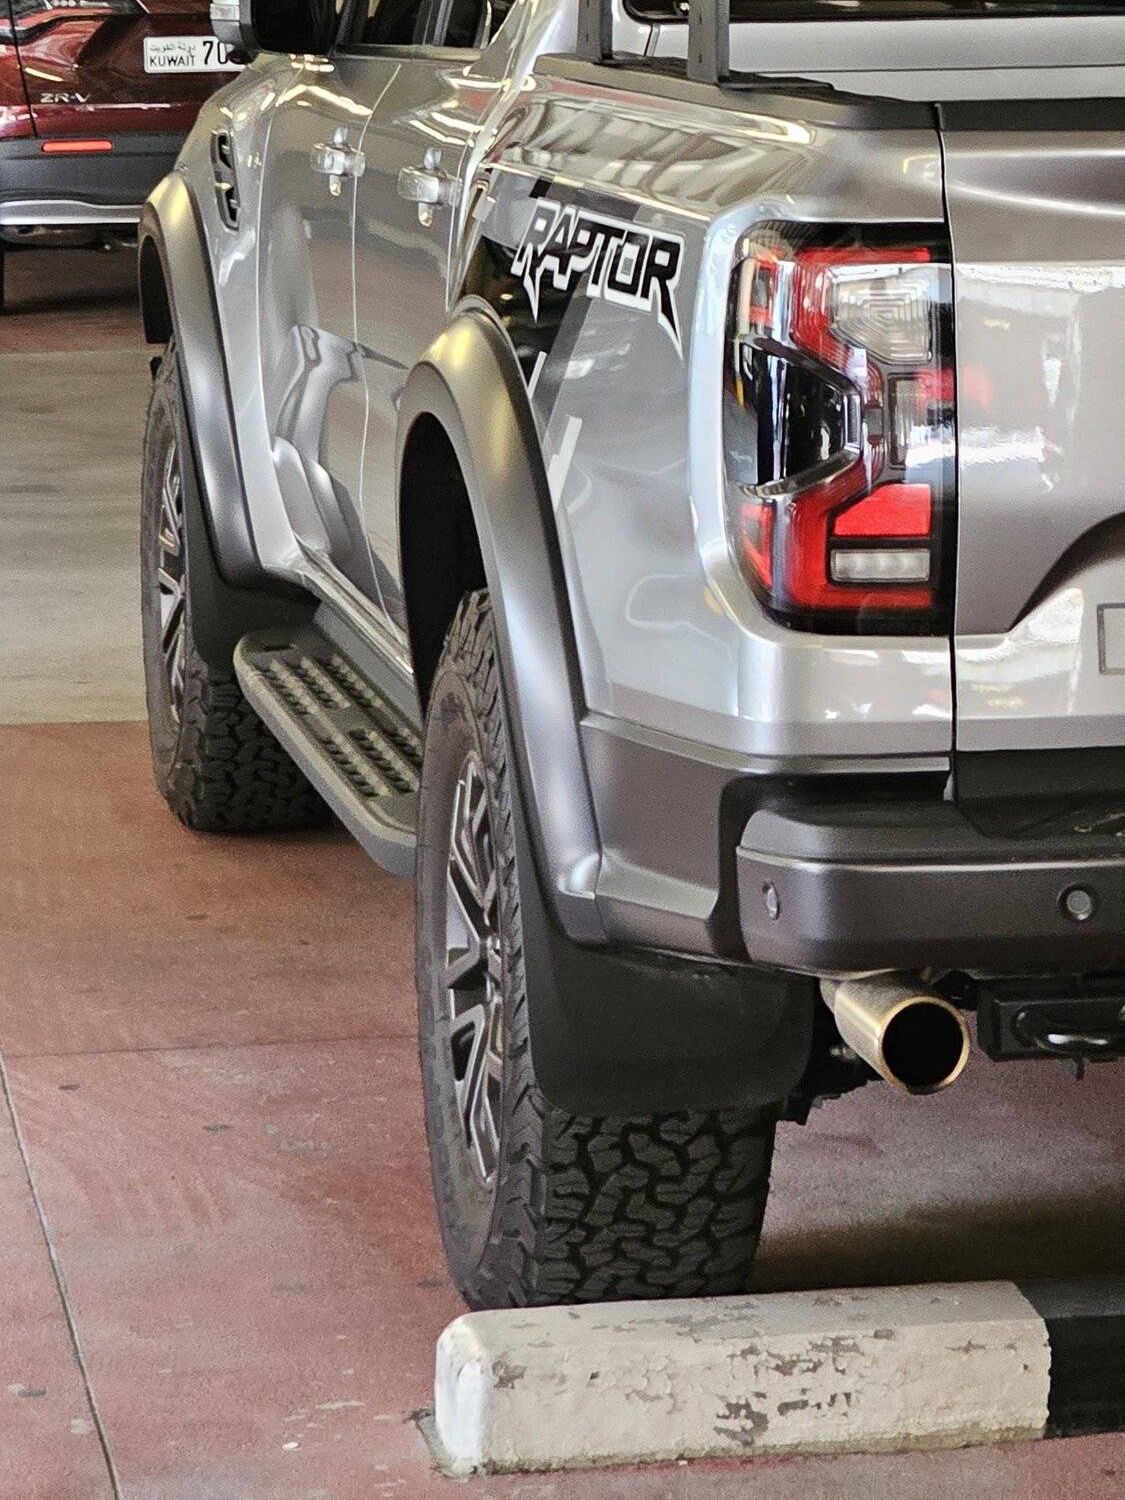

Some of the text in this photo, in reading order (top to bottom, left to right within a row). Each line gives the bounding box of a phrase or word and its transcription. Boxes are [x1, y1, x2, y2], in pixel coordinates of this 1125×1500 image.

[149, 55, 196, 67] KUWAIT
[40, 92, 90, 103] ZR-V
[510, 197, 686, 362] RAPTOR
